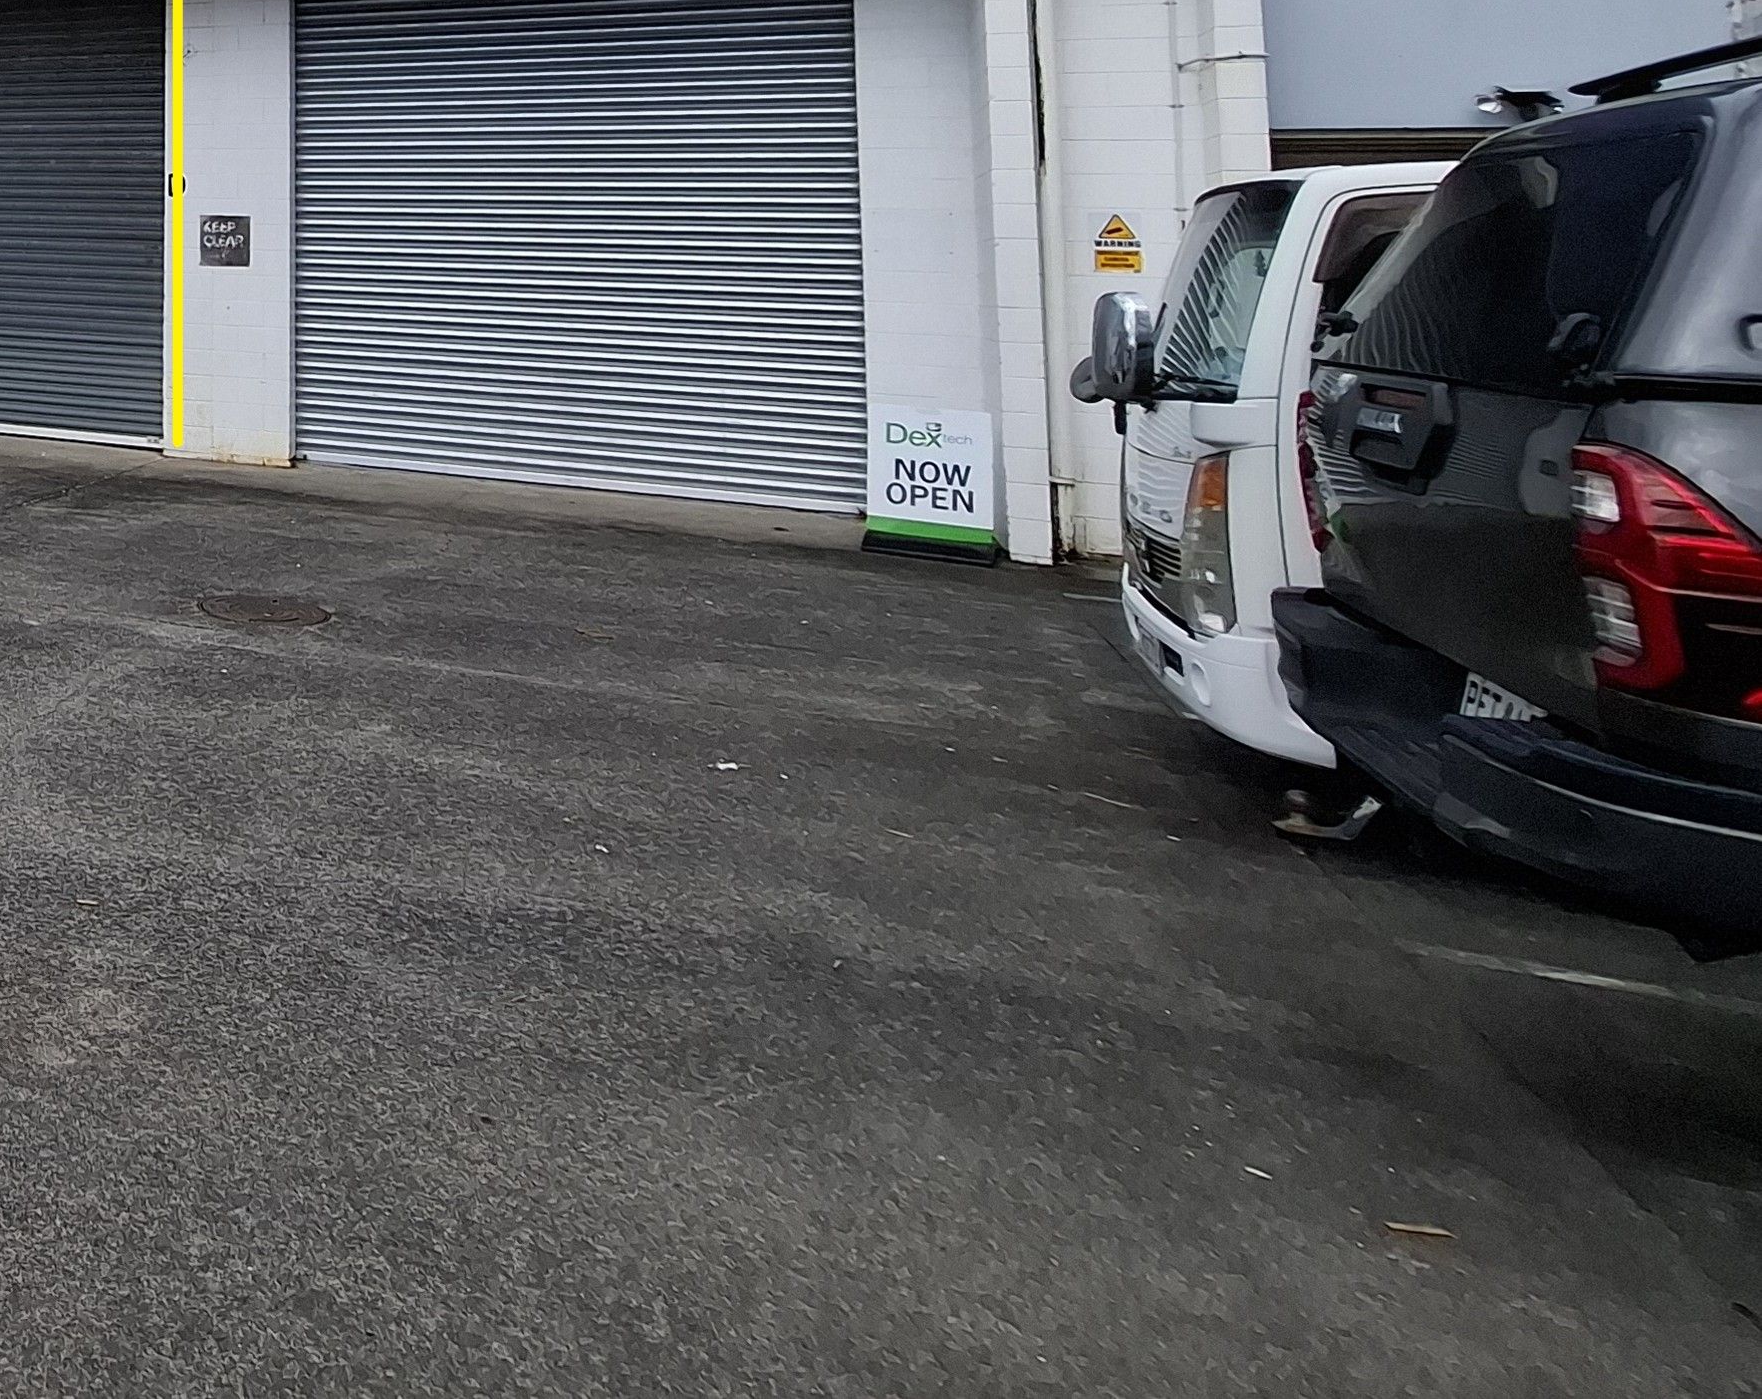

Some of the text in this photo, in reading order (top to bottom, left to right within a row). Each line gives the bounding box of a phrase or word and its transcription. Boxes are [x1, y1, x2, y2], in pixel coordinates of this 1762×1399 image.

[203, 220, 237, 233] KEEP
[894, 458, 972, 487] NOW
[885, 482, 975, 514] OPEN
